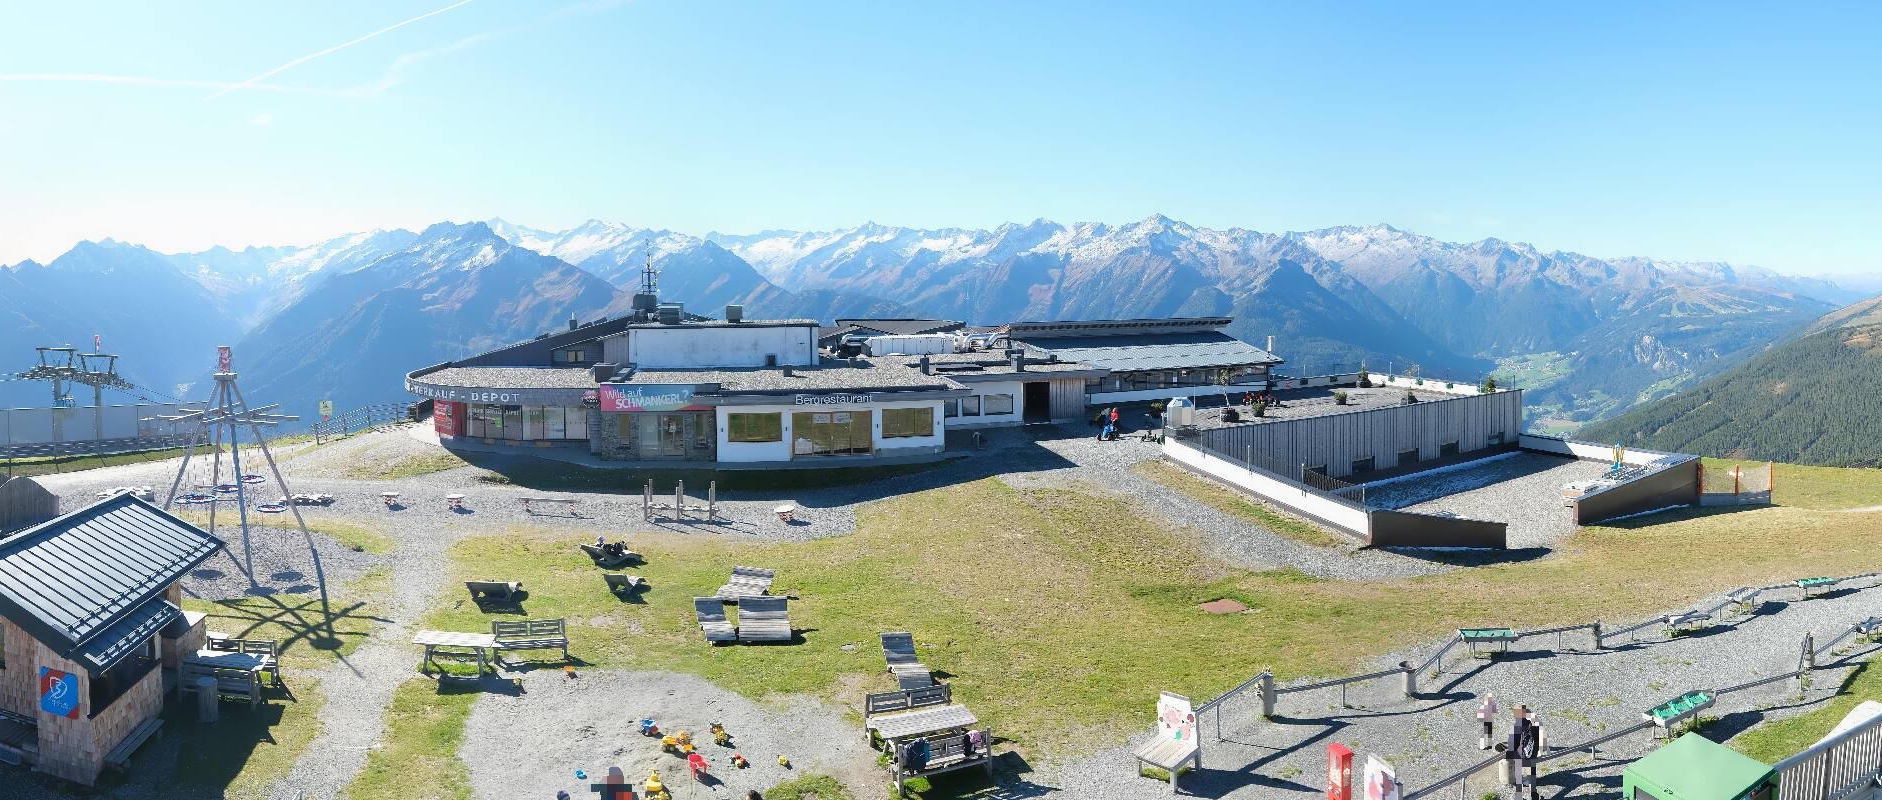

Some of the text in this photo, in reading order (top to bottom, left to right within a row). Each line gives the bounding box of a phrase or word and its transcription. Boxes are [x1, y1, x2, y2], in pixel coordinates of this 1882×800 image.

[471, 392, 520, 402] DEPOT
[605, 387, 626, 400] Wild
[627, 387, 643, 397] auf
[615, 389, 689, 409] SCHMANKERL?
[795, 394, 873, 405] Bergrestaurant
